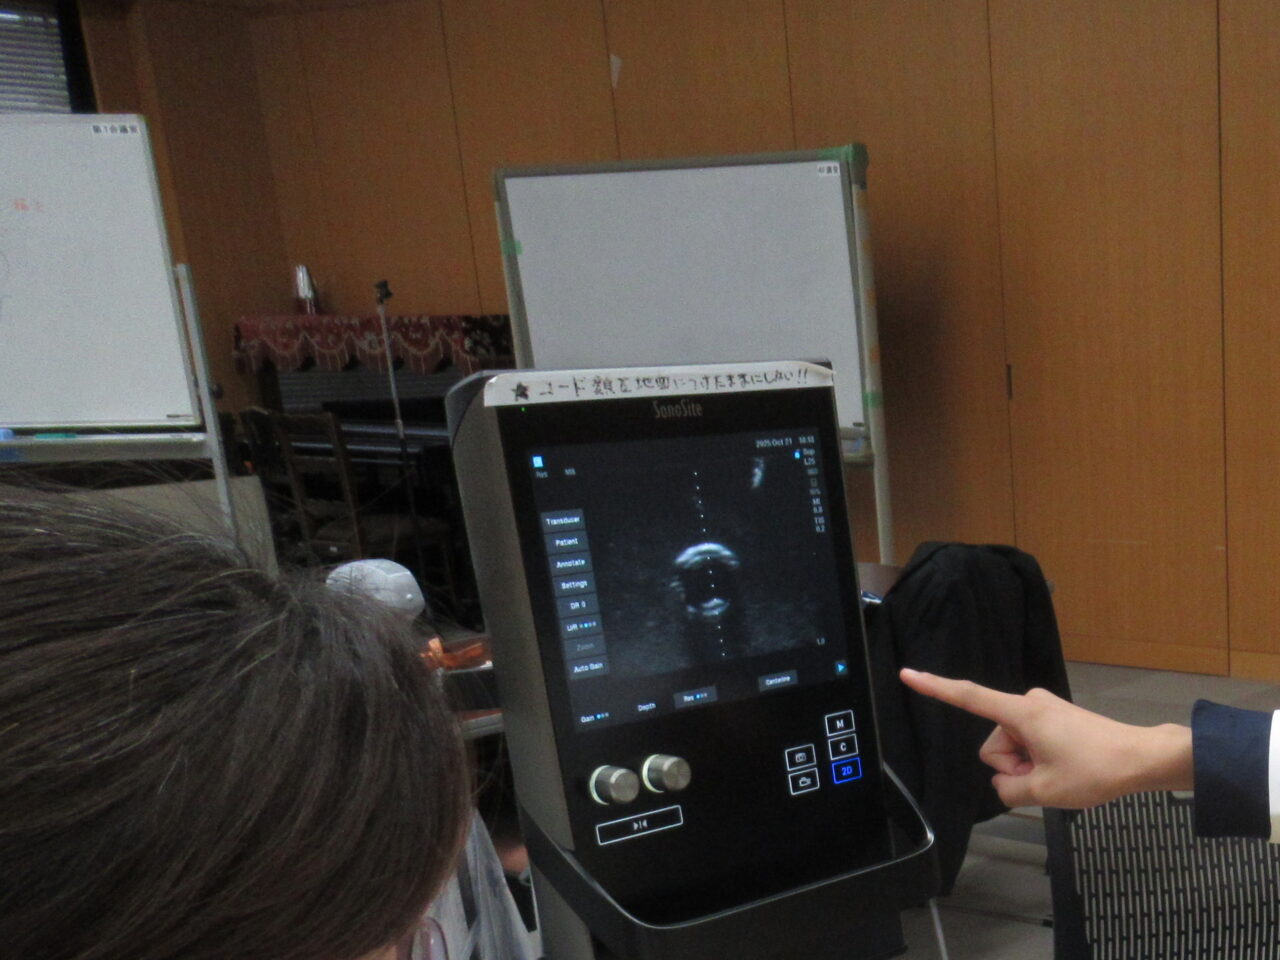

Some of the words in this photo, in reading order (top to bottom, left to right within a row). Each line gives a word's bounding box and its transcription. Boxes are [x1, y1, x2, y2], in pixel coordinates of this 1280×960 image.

[653, 400, 703, 418] SonoSite
[546, 516, 581, 526] Transducer
[555, 537, 579, 547] Patient
[556, 559, 586, 569] Annotate
[561, 580, 588, 590] Settings
[573, 664, 589, 674] Auto
[637, 702, 656, 712] Depth
[580, 714, 595, 723] Gain
[836, 719, 844, 729] M
[840, 742, 847, 752] C
[841, 765, 853, 776] 2D
